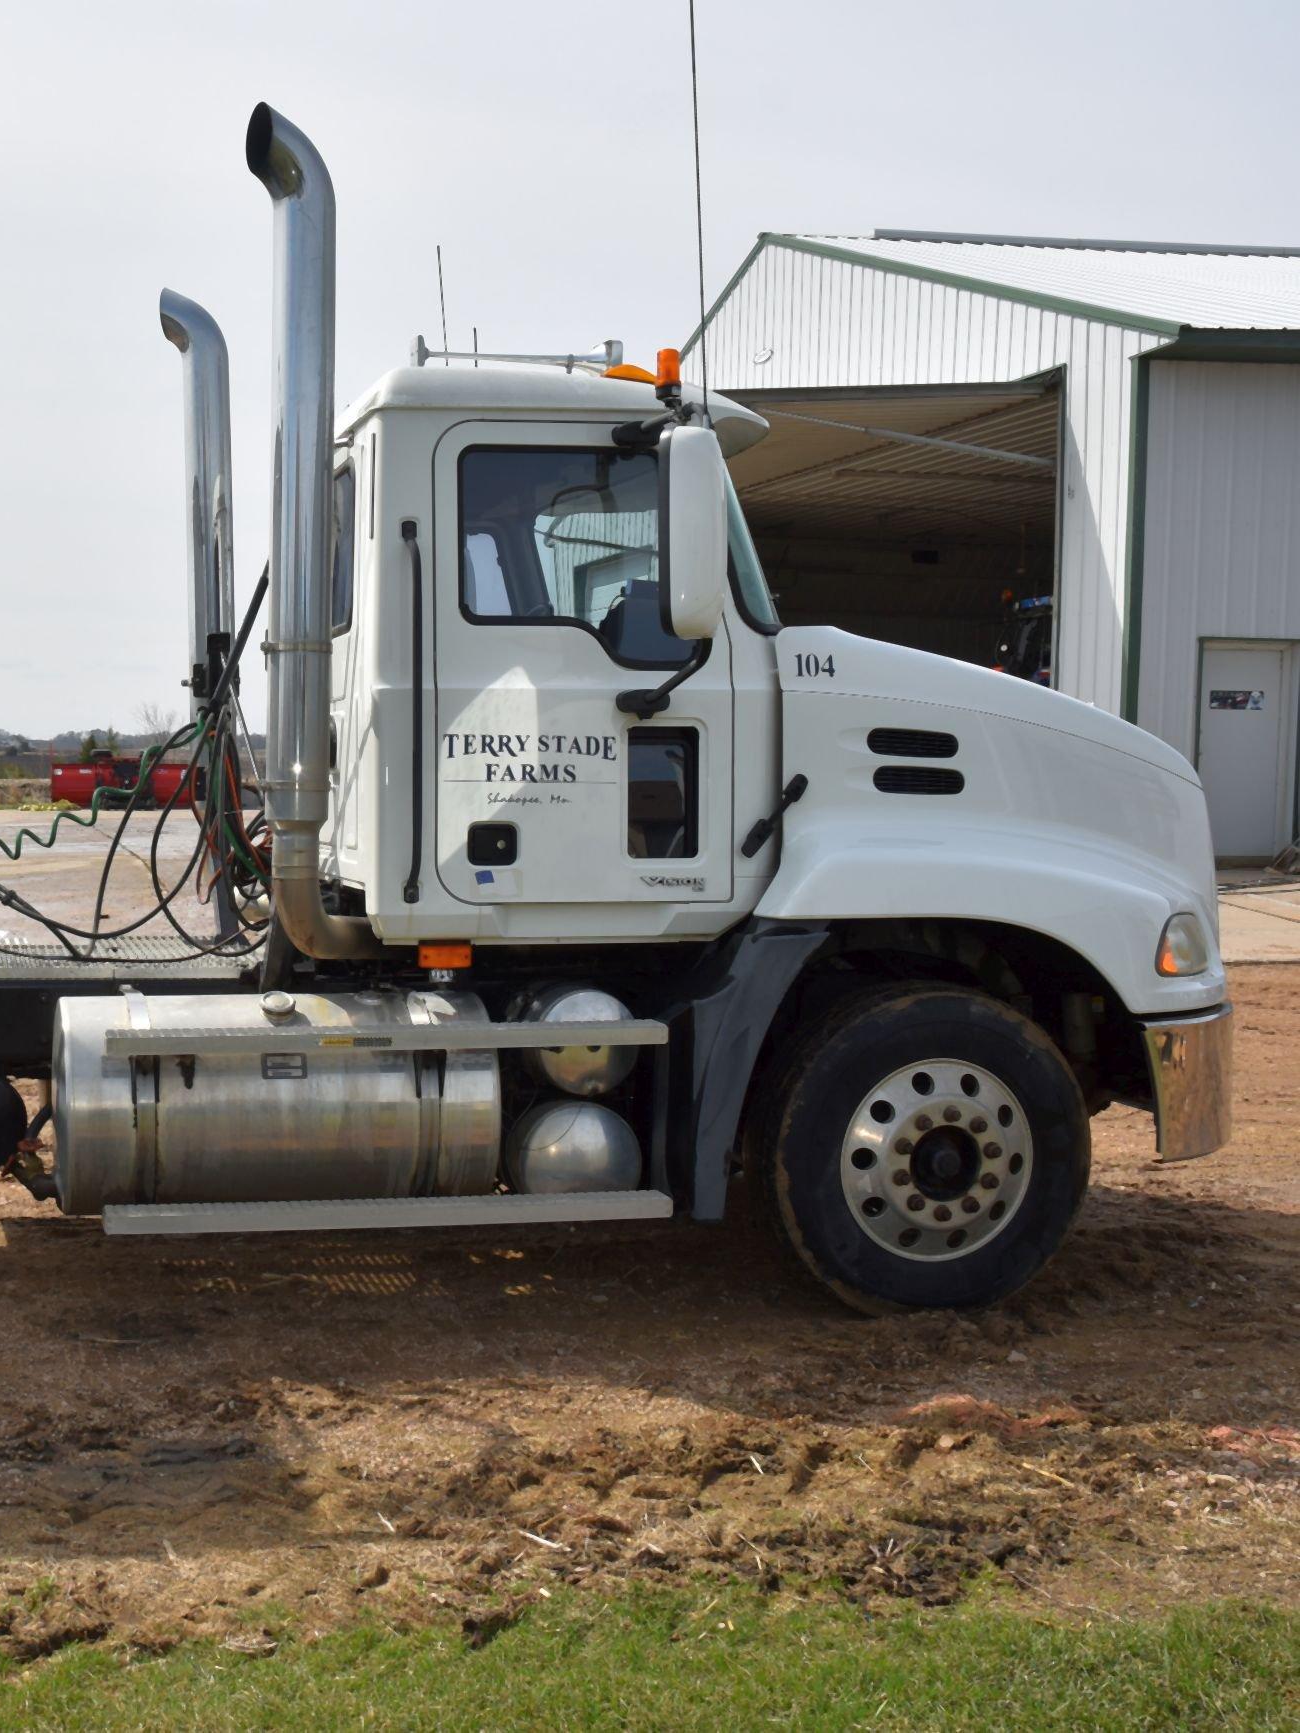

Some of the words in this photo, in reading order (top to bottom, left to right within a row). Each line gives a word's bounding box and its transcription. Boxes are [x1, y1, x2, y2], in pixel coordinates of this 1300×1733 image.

[794, 653, 836, 678] 104
[442, 733, 530, 759] TERRY
[537, 734, 617, 761] STADE
[485, 763, 576, 783] FARMS
